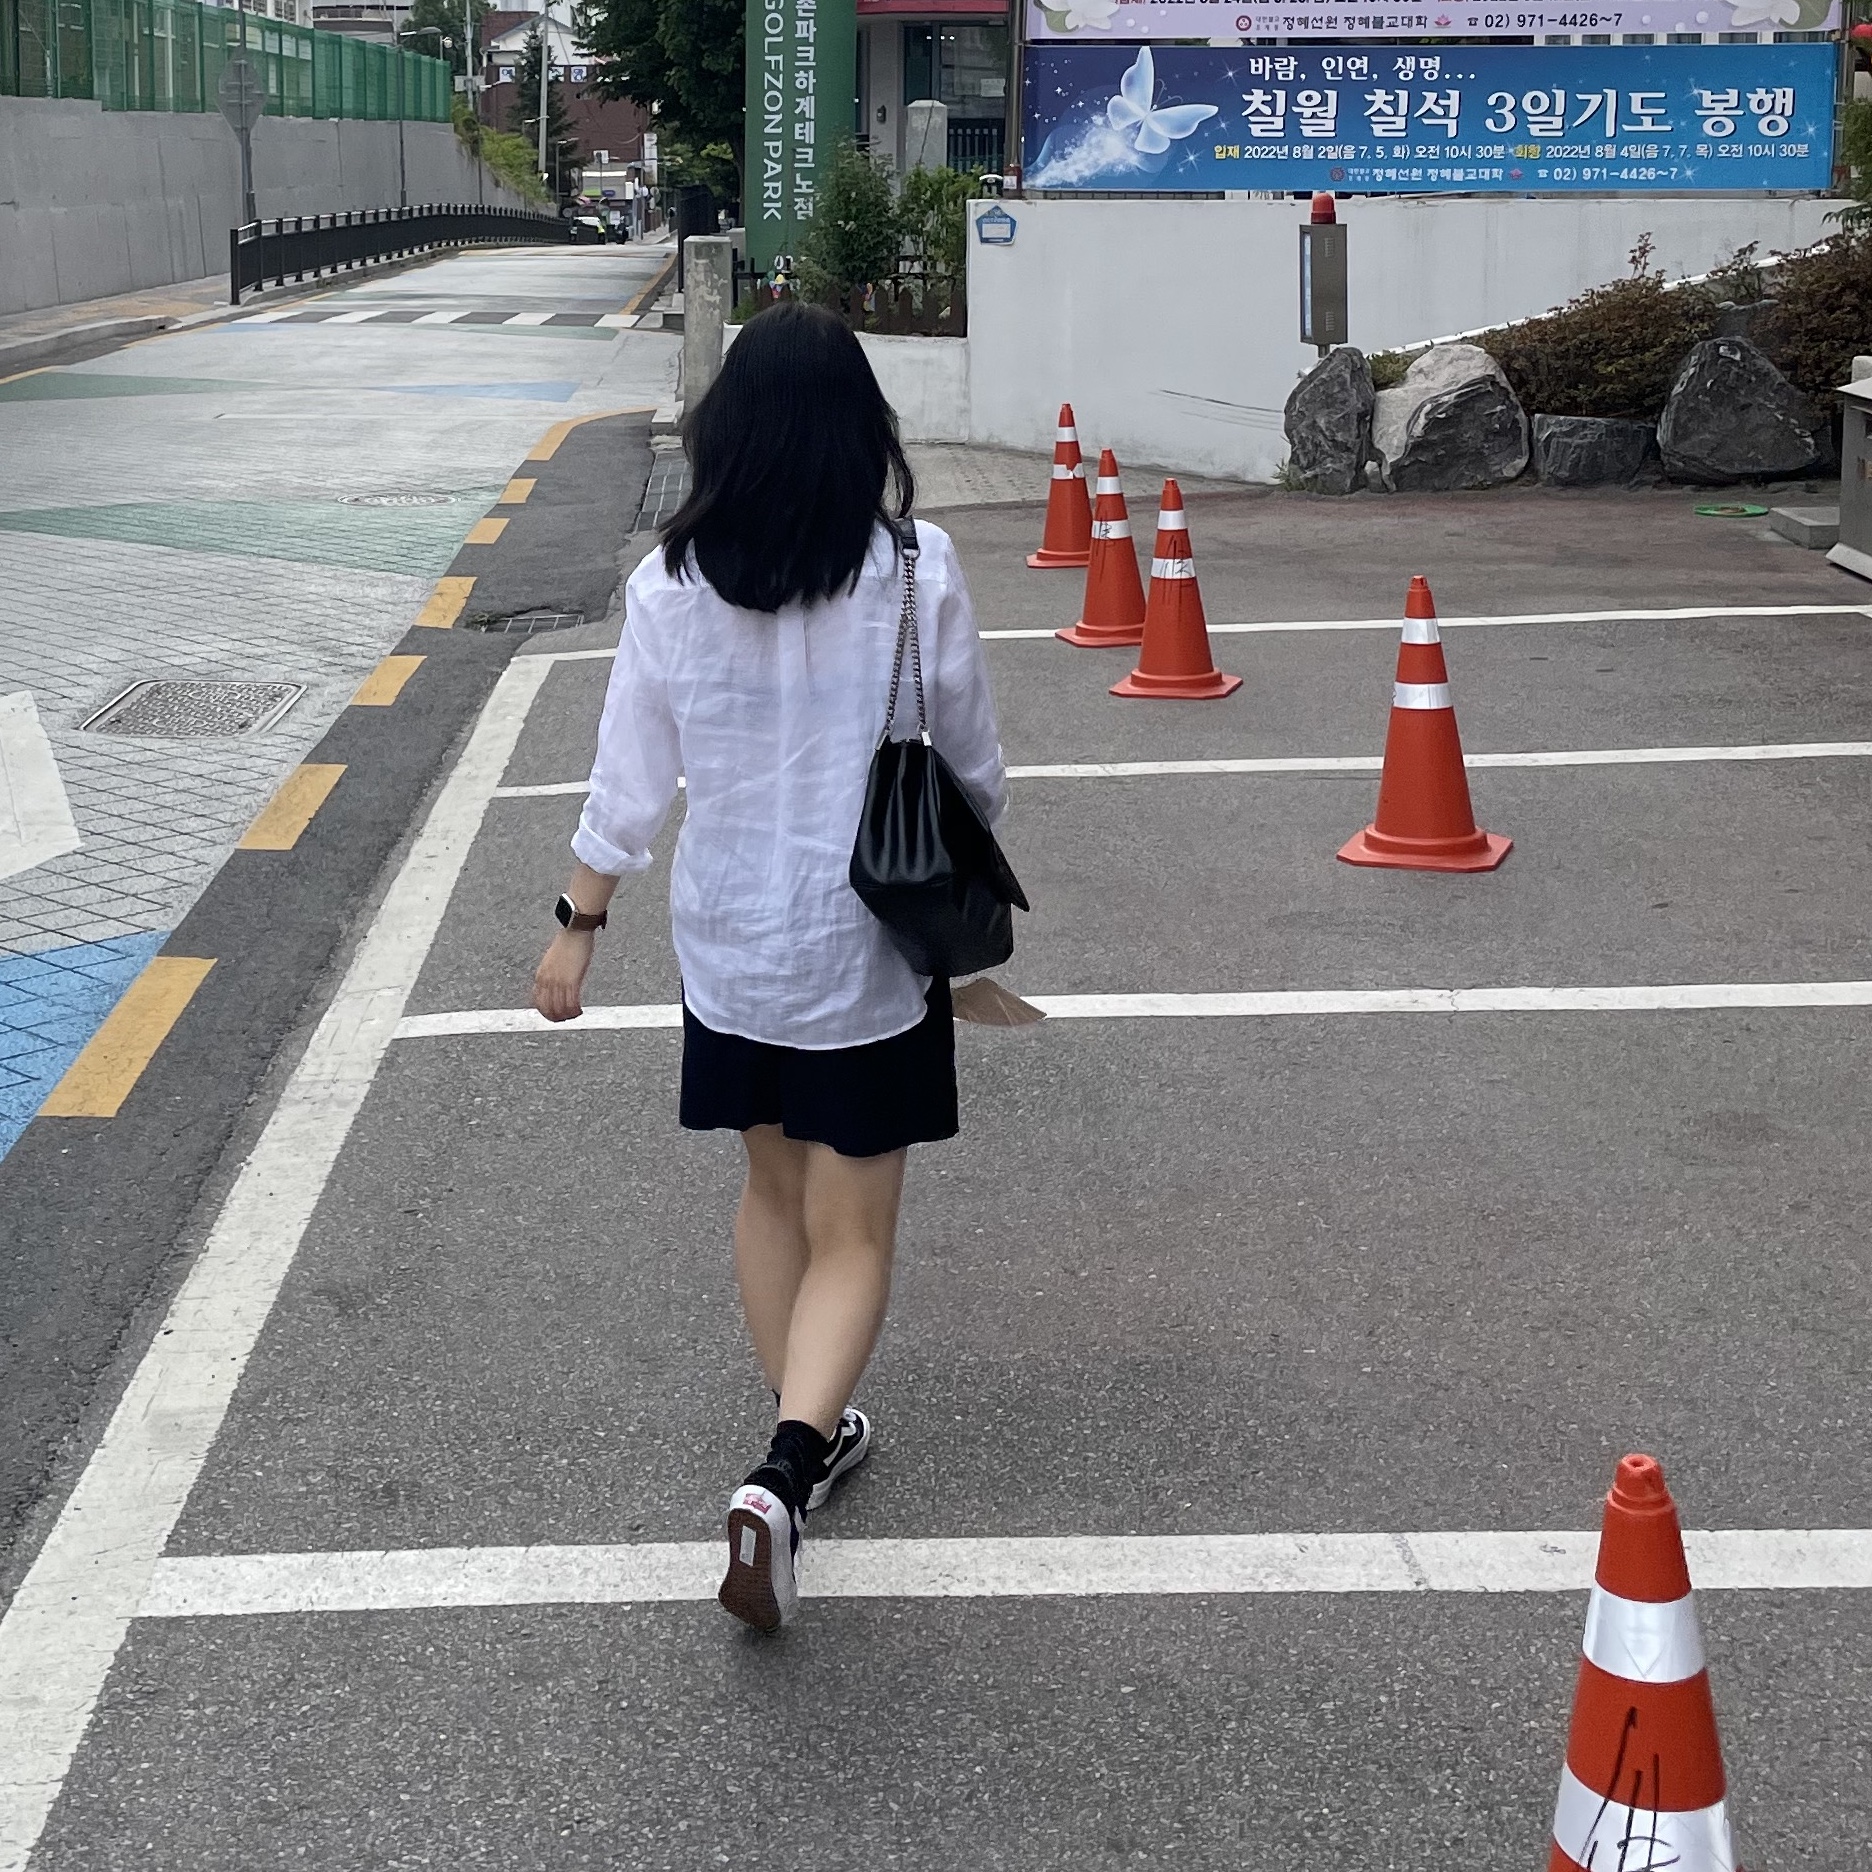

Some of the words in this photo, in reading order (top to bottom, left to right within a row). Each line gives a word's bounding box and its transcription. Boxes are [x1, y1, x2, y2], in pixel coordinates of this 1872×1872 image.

[1484, 13, 1510, 29] 02)
[1517, 13, 1623, 28] 971-4426~7
[1249, 55, 1306, 82] 바람,
[1321, 55, 1378, 82] 인연,
[1392, 55, 1476, 82] 생명...
[1241, 88, 1338, 138] 칠월
[1363, 88, 1462, 138] 칠석
[1485, 88, 1673, 138] 3일기도
[1694, 87, 1796, 137] 봉행
[1214, 145, 1240, 160] 입재
[1244, 145, 1289, 160] 2022년
[1292, 145, 1314, 160] 8월
[1392, 145, 1411, 160] 화)
[1414, 145, 1440, 160] 오전
[1445, 145, 1472, 160] 10시
[1475, 145, 1505, 160] 30분
[1546, 144, 1591, 159] 2022년
[1595, 144, 1616, 159] 8월
[1695, 143, 1713, 158] 목)
[1716, 143, 1743, 158] 오전
[1748, 143, 1775, 158] 10시
[1779, 143, 1809, 158] 30분
[763, 140, 783, 220] PARK
[1553, 167, 1577, 181] 02)
[1582, 167, 1678, 180] 971-4426~7
